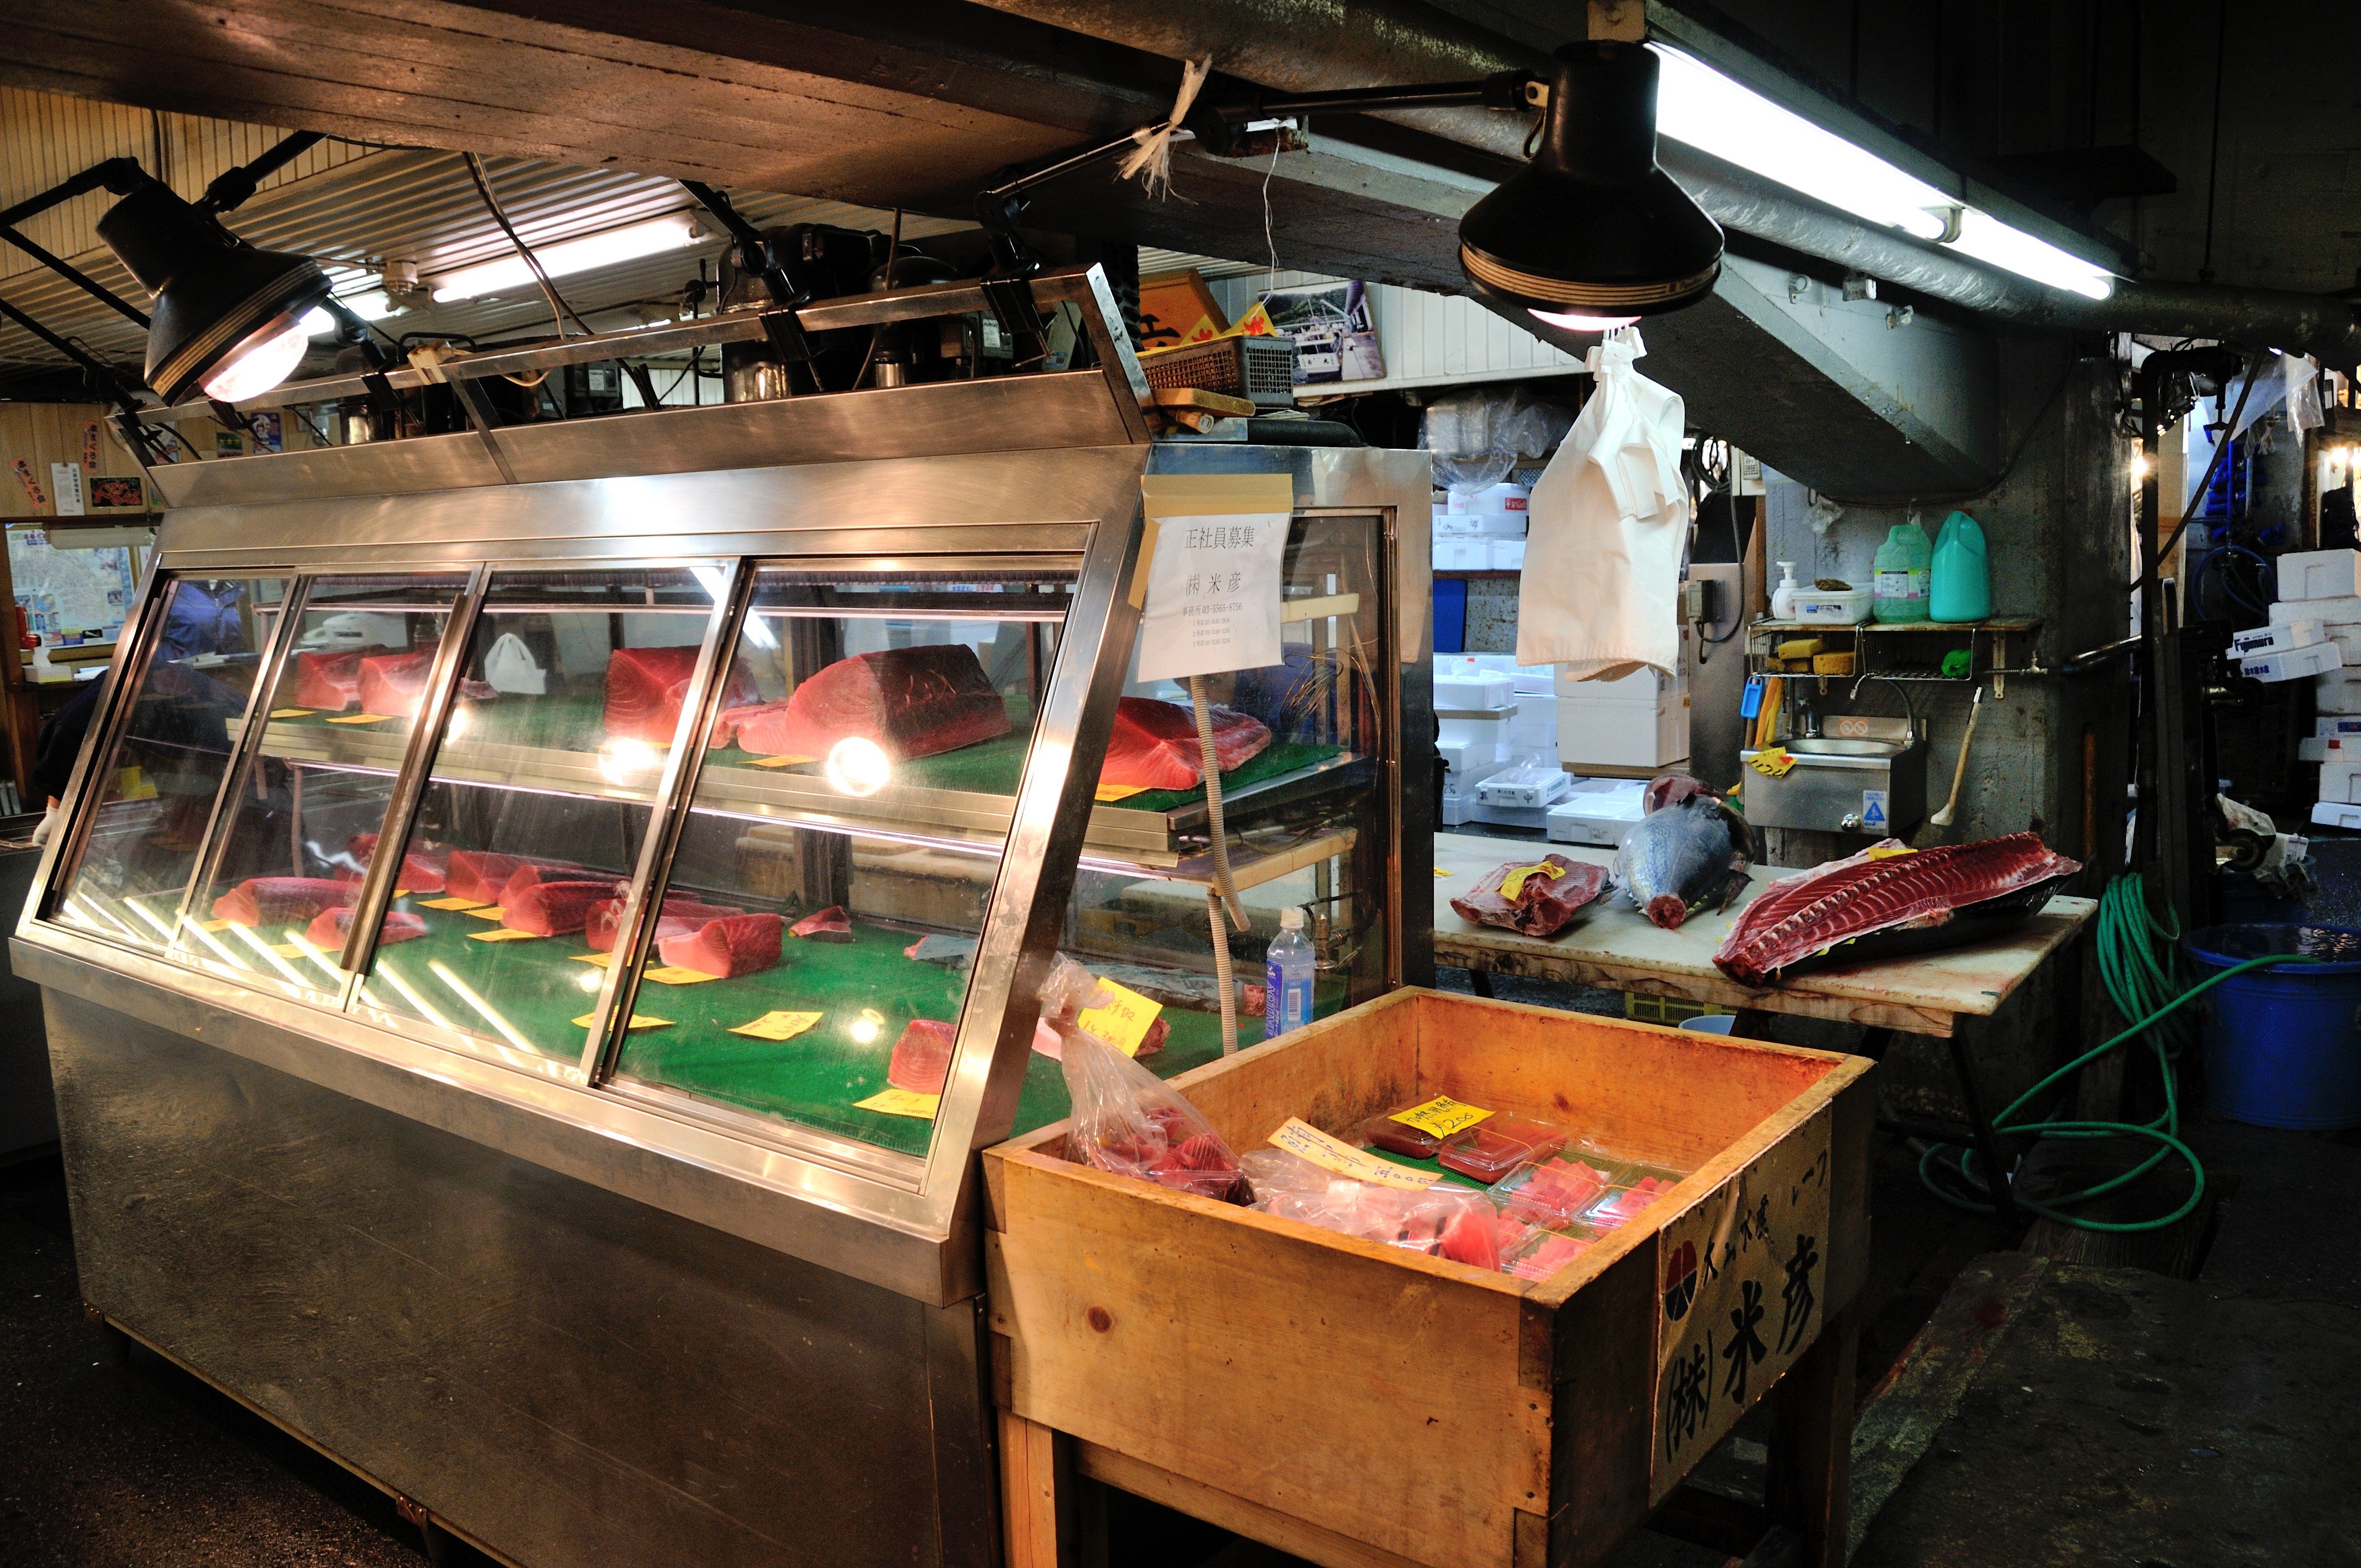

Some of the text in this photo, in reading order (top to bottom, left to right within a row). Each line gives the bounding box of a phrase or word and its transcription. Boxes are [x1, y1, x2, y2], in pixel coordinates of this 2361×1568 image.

[1184, 526, 1255, 549] 正社員募集
[1182, 602, 1243, 617] 事務所 03-5565-8756
